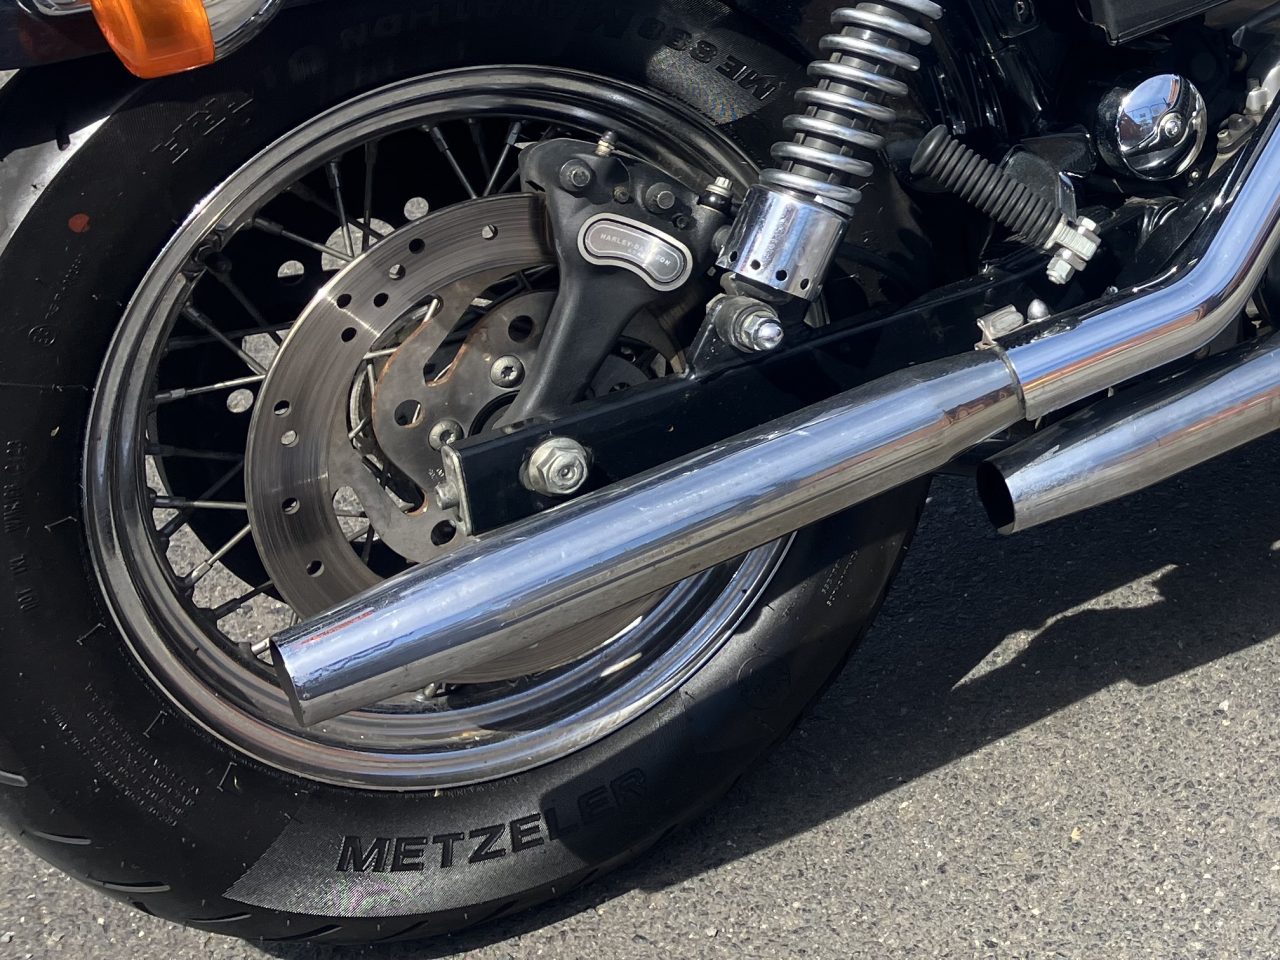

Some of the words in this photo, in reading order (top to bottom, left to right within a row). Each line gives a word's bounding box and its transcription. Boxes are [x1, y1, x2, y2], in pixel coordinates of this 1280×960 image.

[714, 53, 778, 101] ME
[600, 232, 672, 267] HARLEY-DASON
[335, 767, 646, 873] METZELER
